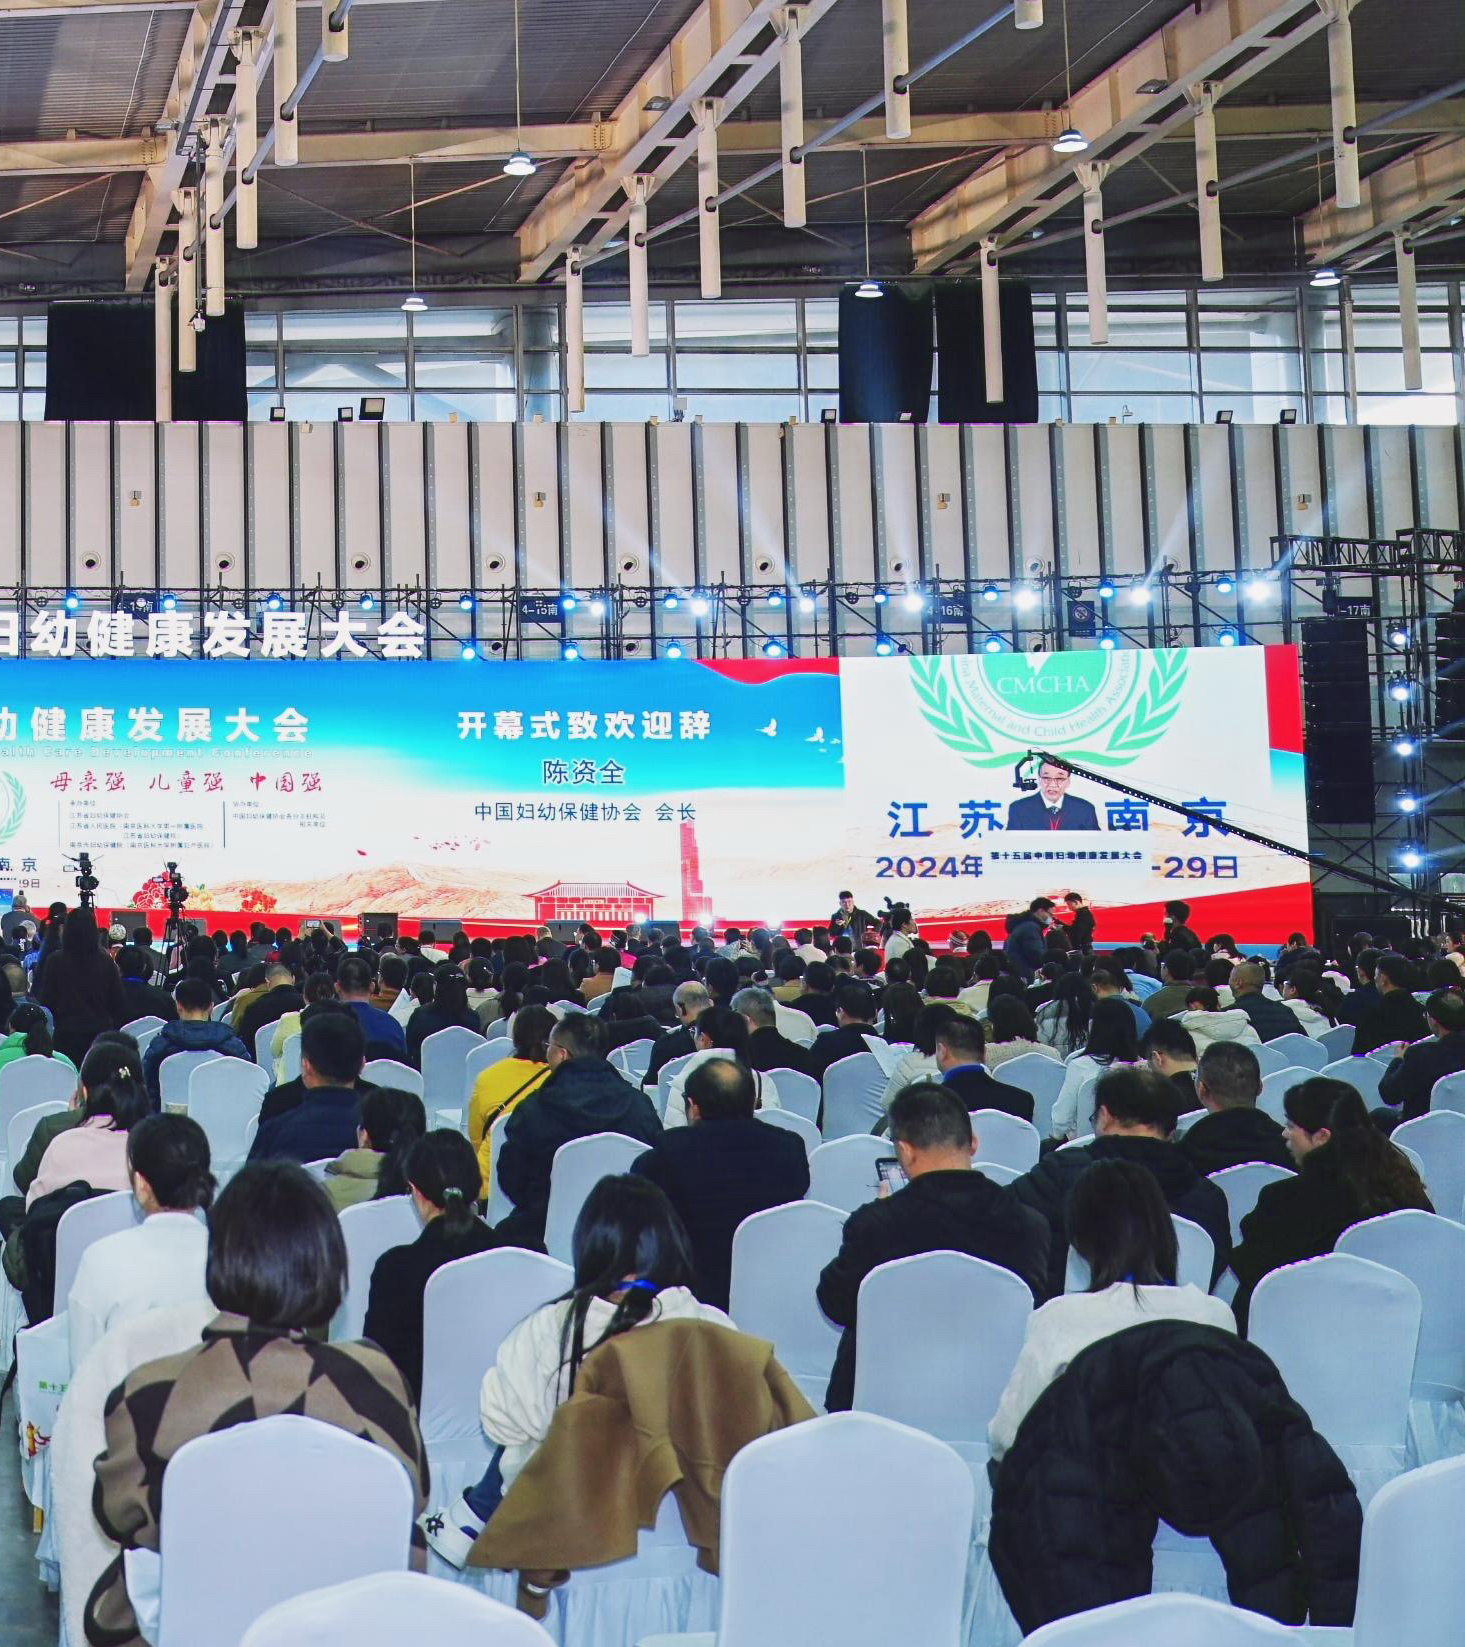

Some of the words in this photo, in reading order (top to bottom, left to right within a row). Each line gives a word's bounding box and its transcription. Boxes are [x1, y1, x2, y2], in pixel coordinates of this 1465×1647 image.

[1337, 604, 1371, 617] -17南
[997, 674, 1091, 695] CMCHA
[457, 710, 712, 741] 开幕式致欢迎辞
[49, 770, 126, 793] 母亲强
[148, 770, 225, 794] 儿童强
[248, 770, 324, 794] 中国强
[541, 759, 626, 786] 陈资全
[474, 801, 642, 823] 中国妇幼保健协会
[655, 801, 697, 822] 会长
[887, 800, 1005, 839] 江苏
[1104, 796, 1230, 838] 南京
[875, 854, 983, 878] 2024年
[1151, 855, 1239, 879] -29日
